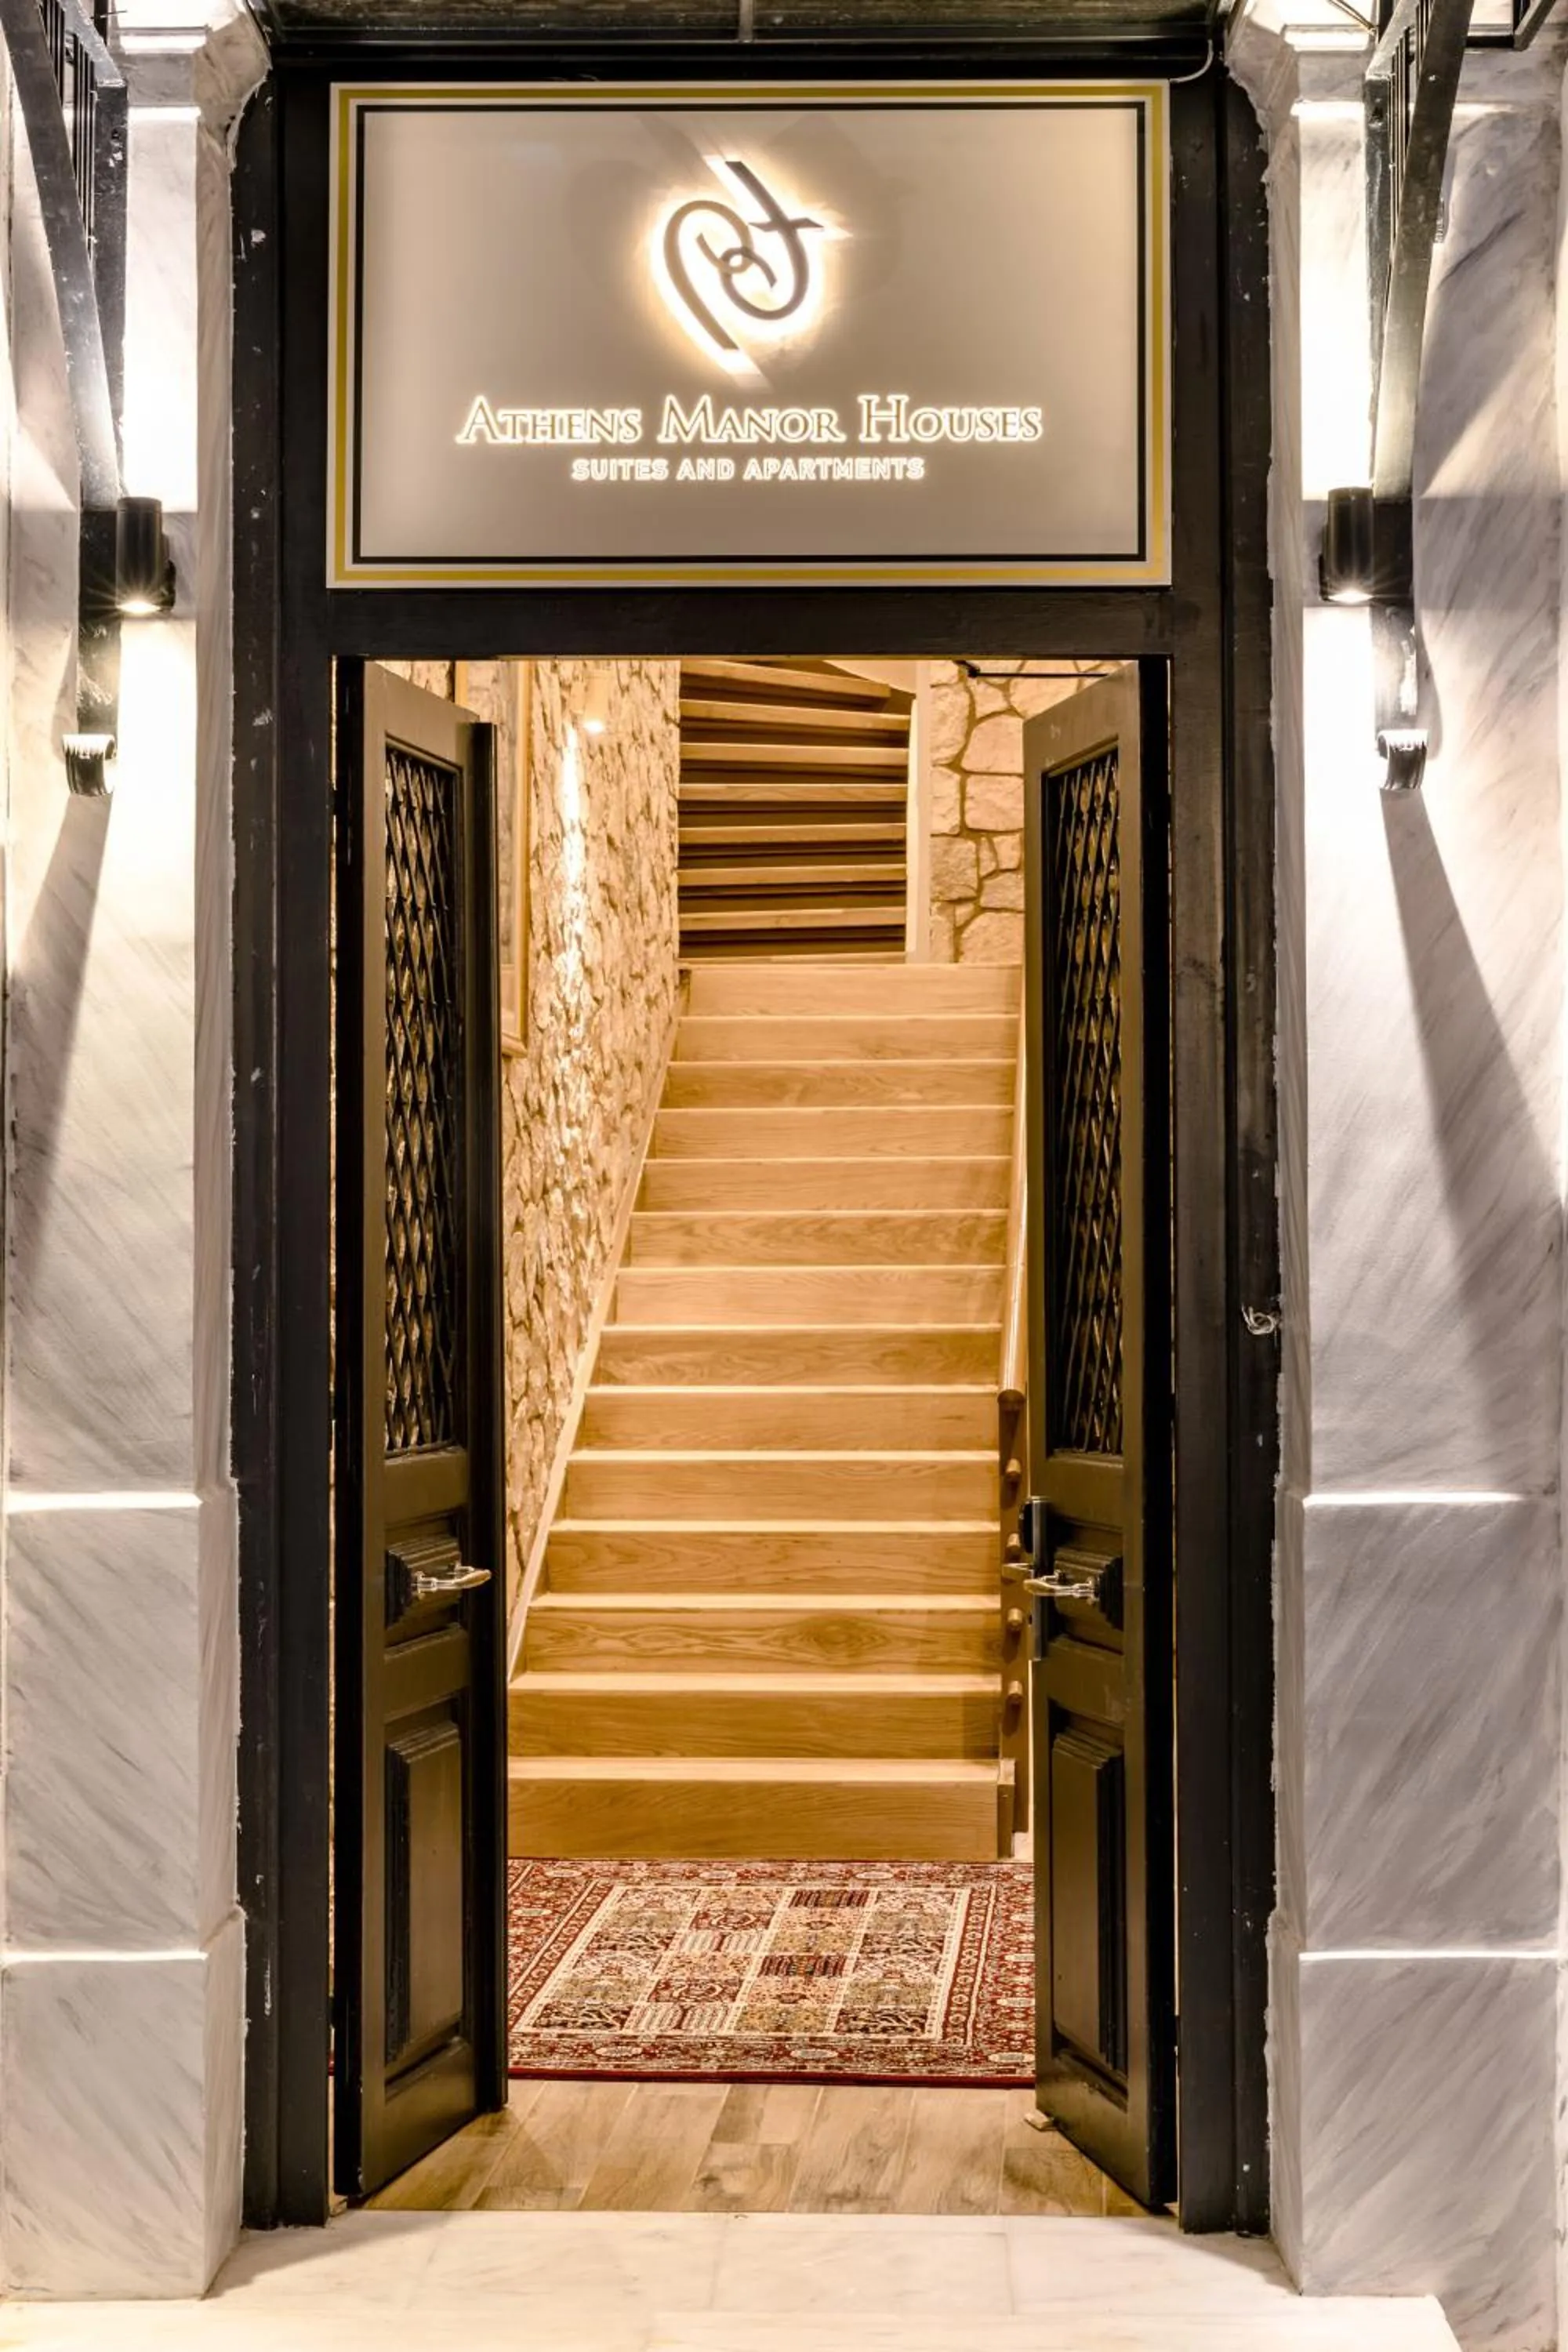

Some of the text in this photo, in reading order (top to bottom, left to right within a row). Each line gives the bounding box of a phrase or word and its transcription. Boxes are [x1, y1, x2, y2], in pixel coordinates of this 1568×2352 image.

[456, 395, 1043, 445] ATHENS MANOR HOUSES
[571, 457, 926, 482] SUITES AND APARTMENTS
